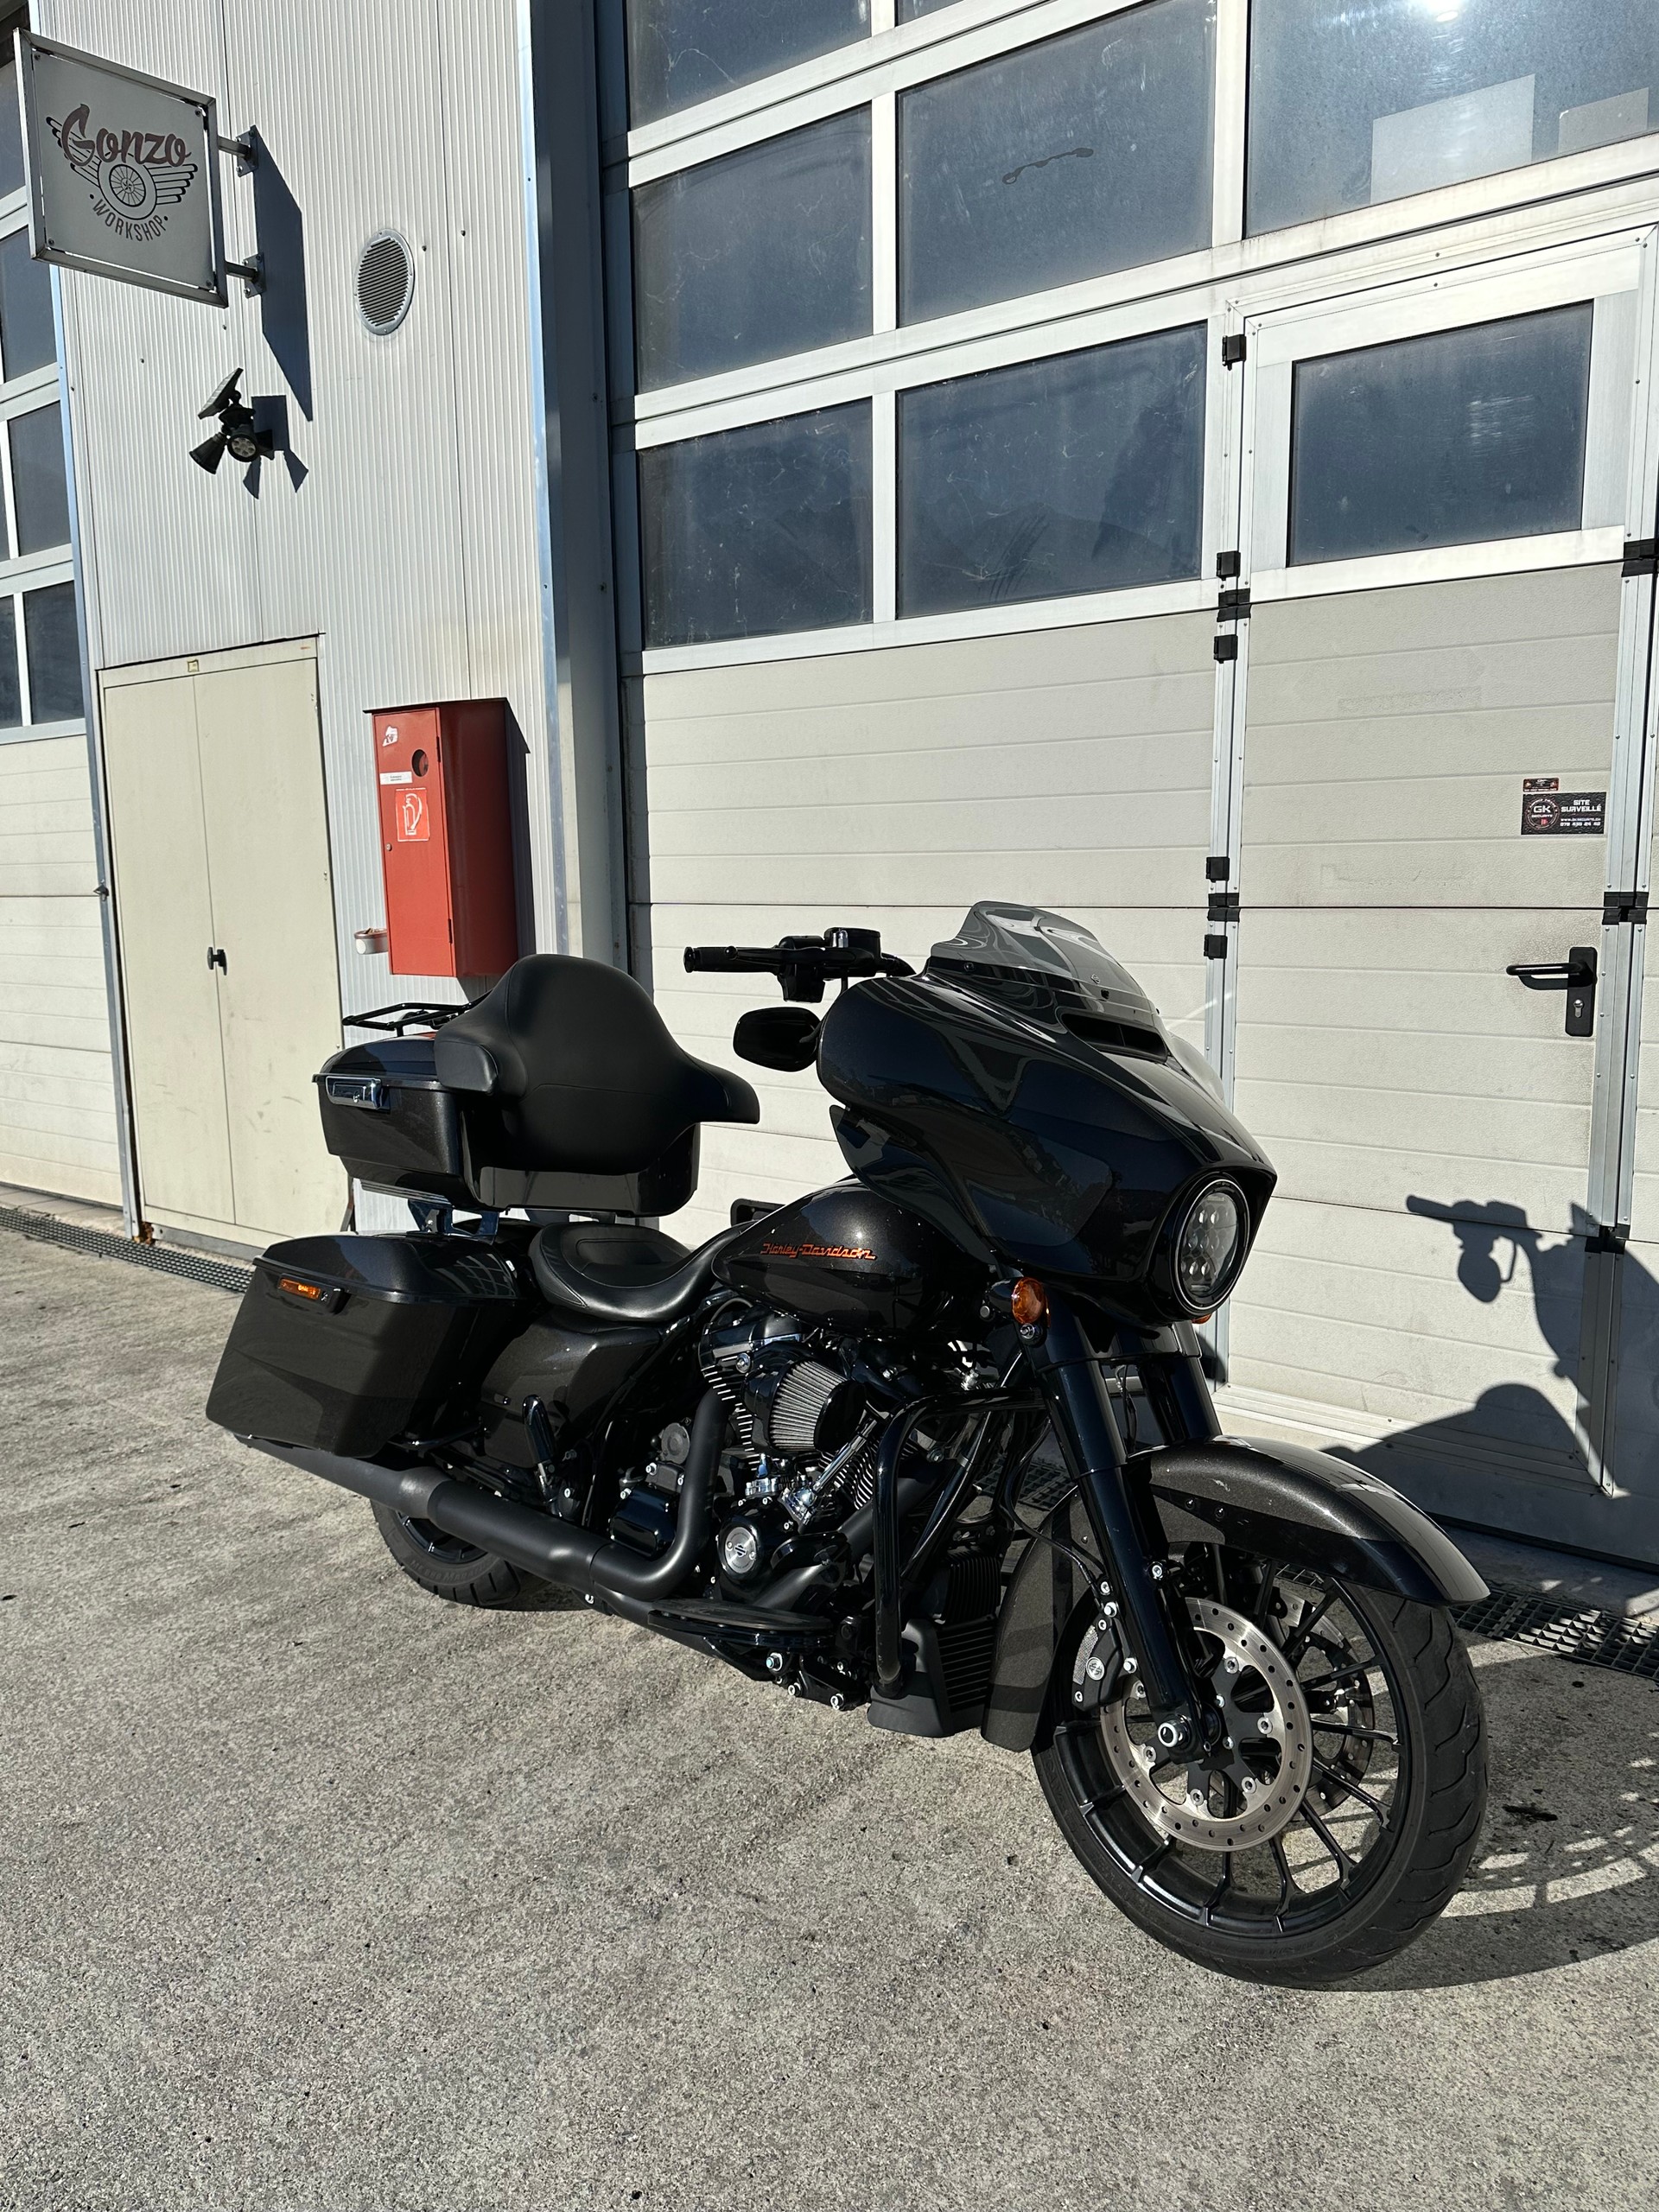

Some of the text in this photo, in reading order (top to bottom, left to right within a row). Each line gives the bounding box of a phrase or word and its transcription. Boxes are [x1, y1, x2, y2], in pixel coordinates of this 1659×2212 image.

[61, 103, 193, 168] Gonzo
[92, 199, 168, 242] WORKSHOP
[1560, 804, 1602, 812] SURVEILLÉ
[760, 1243, 876, 1261] Harley-Davidson
